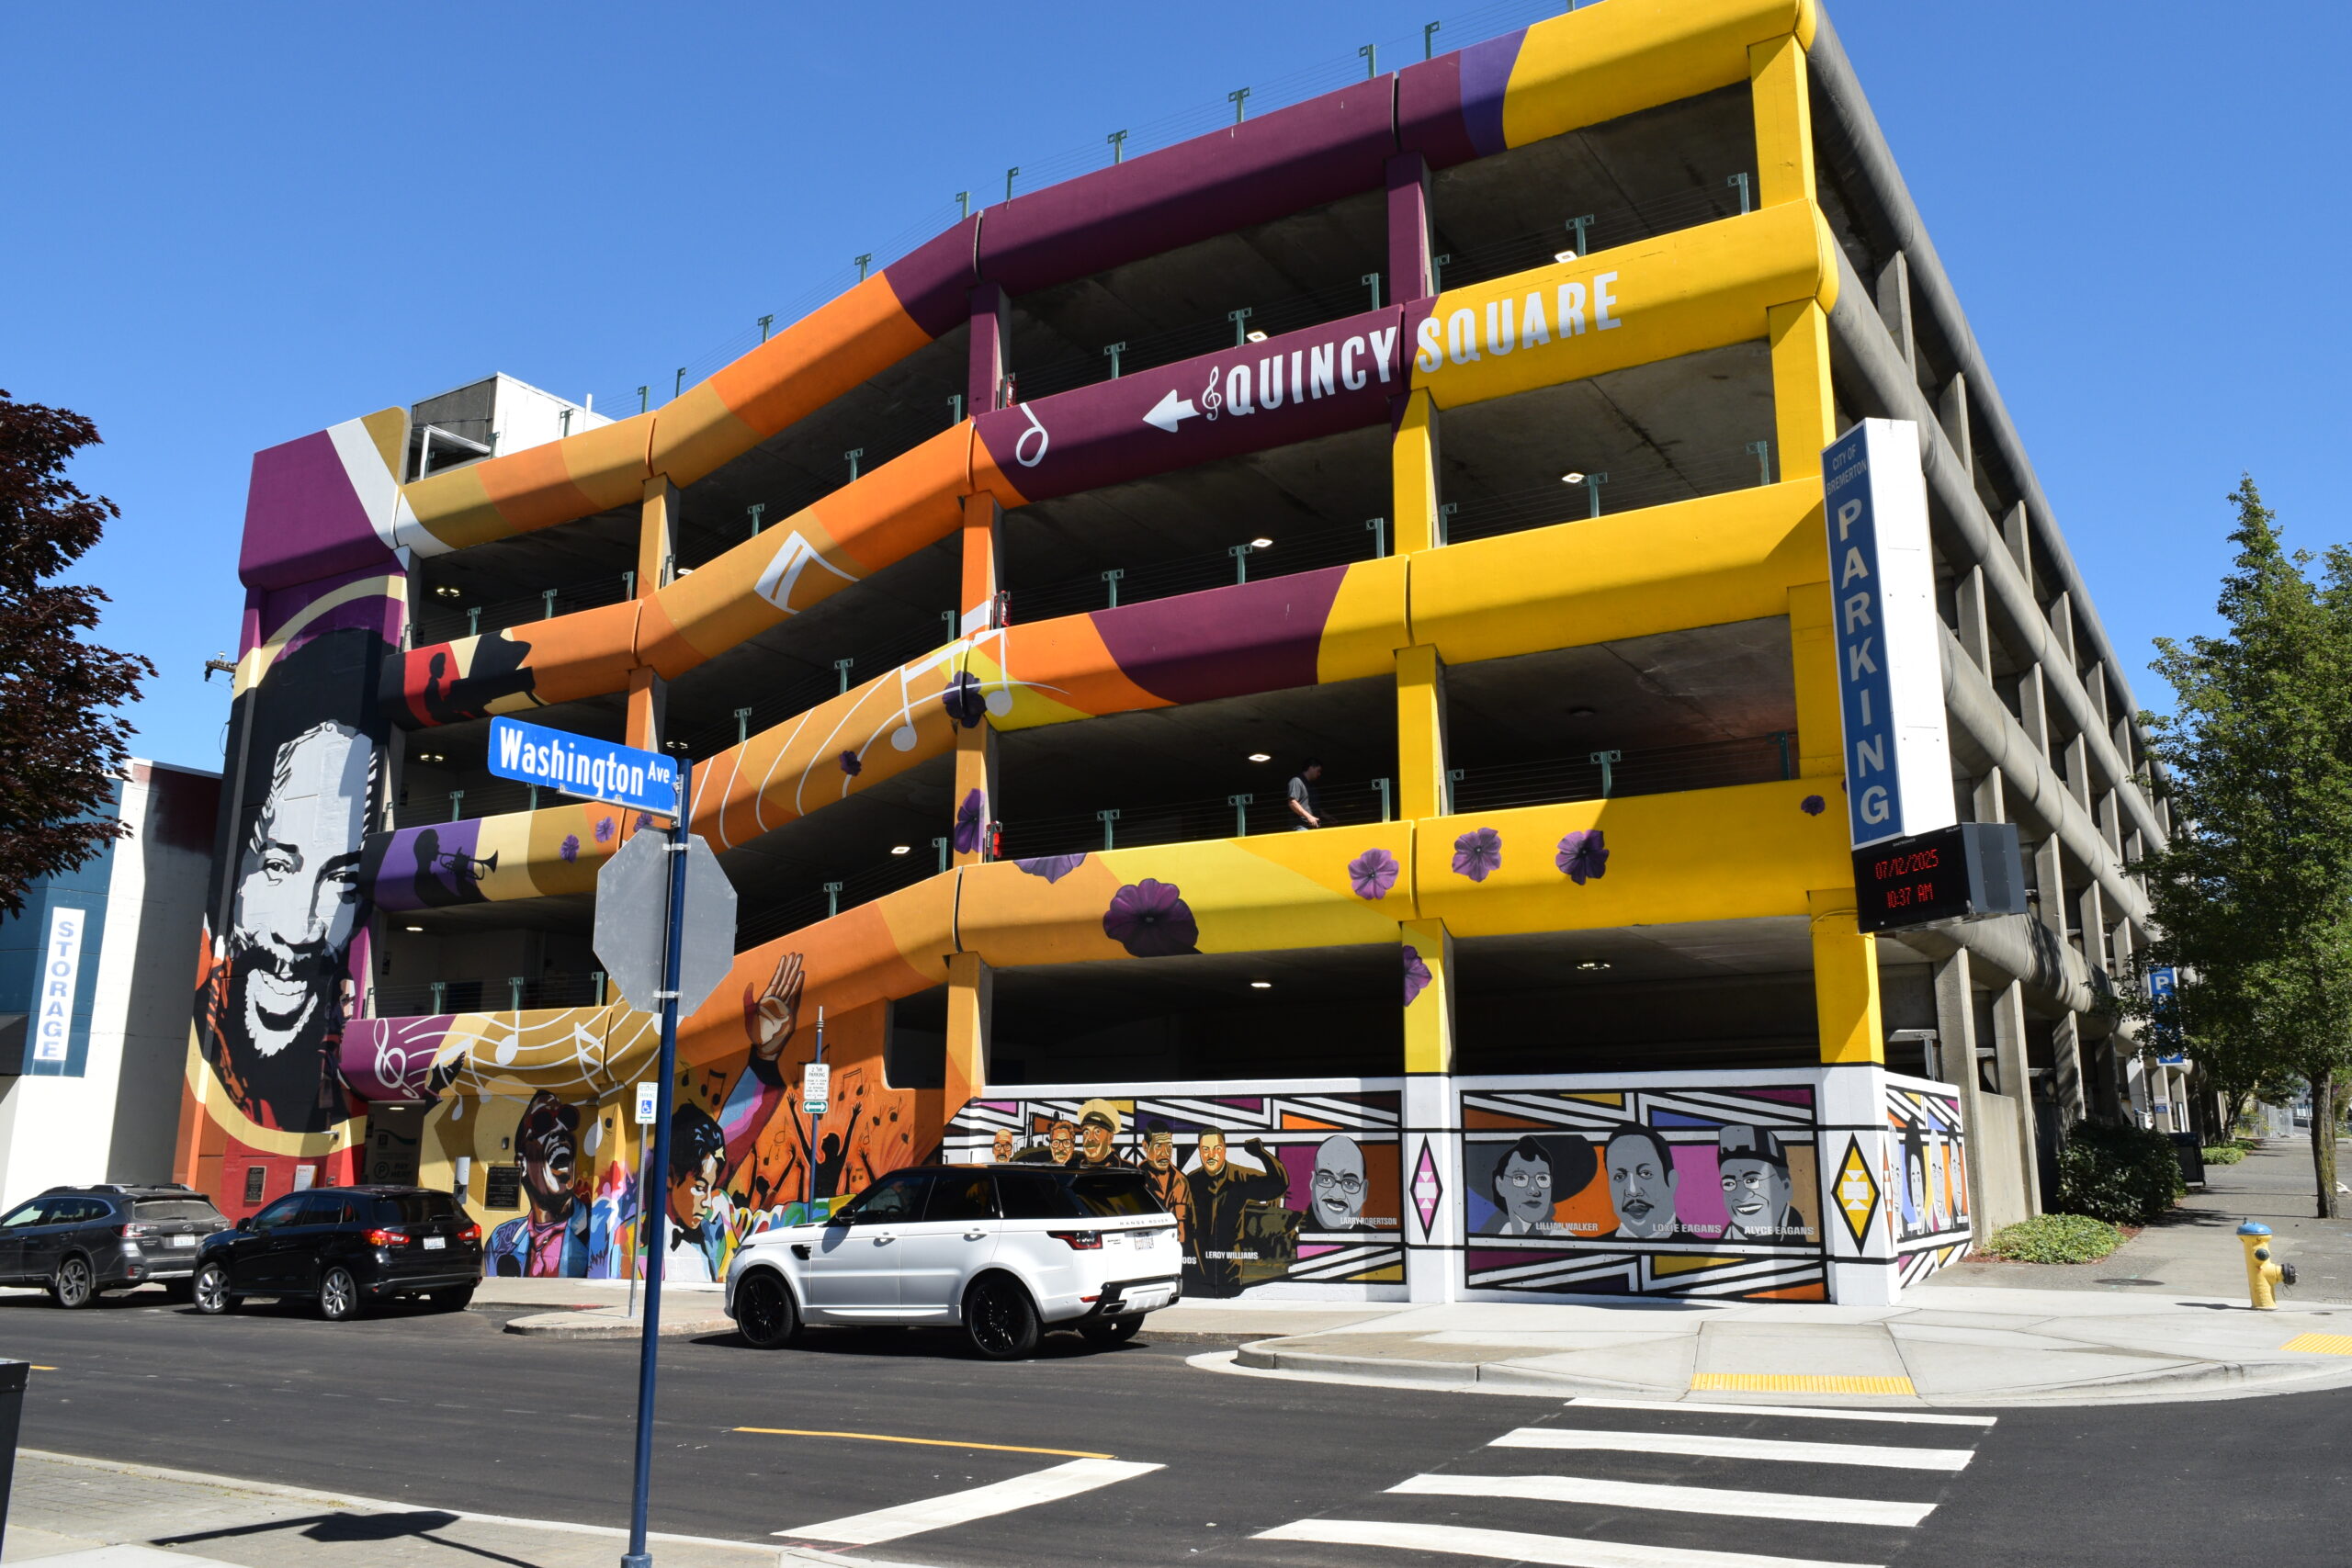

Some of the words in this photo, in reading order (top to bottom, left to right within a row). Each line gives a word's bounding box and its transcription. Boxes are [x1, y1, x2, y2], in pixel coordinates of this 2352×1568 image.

[1226, 326, 1397, 416] QUINCY
[1417, 270, 1622, 373] SQUARE
[1832, 450, 1847, 470] CITY
[1847, 444, 1856, 460] OF
[1826, 457, 1867, 496] BREMERTON
[1837, 497, 1890, 826] PARKING
[500, 726, 644, 797] Washington
[648, 761, 671, 784] Ave
[1874, 849, 1939, 880] 07/12/2025
[1886, 887, 1911, 908] 10:37
[1917, 883, 1934, 903] AM
[42, 920, 74, 1057] STORAGE
[1361, 1217, 1397, 1225] ROBERTSON
[1565, 1223, 1598, 1231] WALKER
[1653, 1224, 1679, 1233] LOXIE
[1681, 1224, 1722, 1233] EAGANS
[1745, 1225, 1773, 1235] ALYCE
[1775, 1226, 1815, 1235] EAGANS
[1227, 1251, 1259, 1259] WILLIAMS
